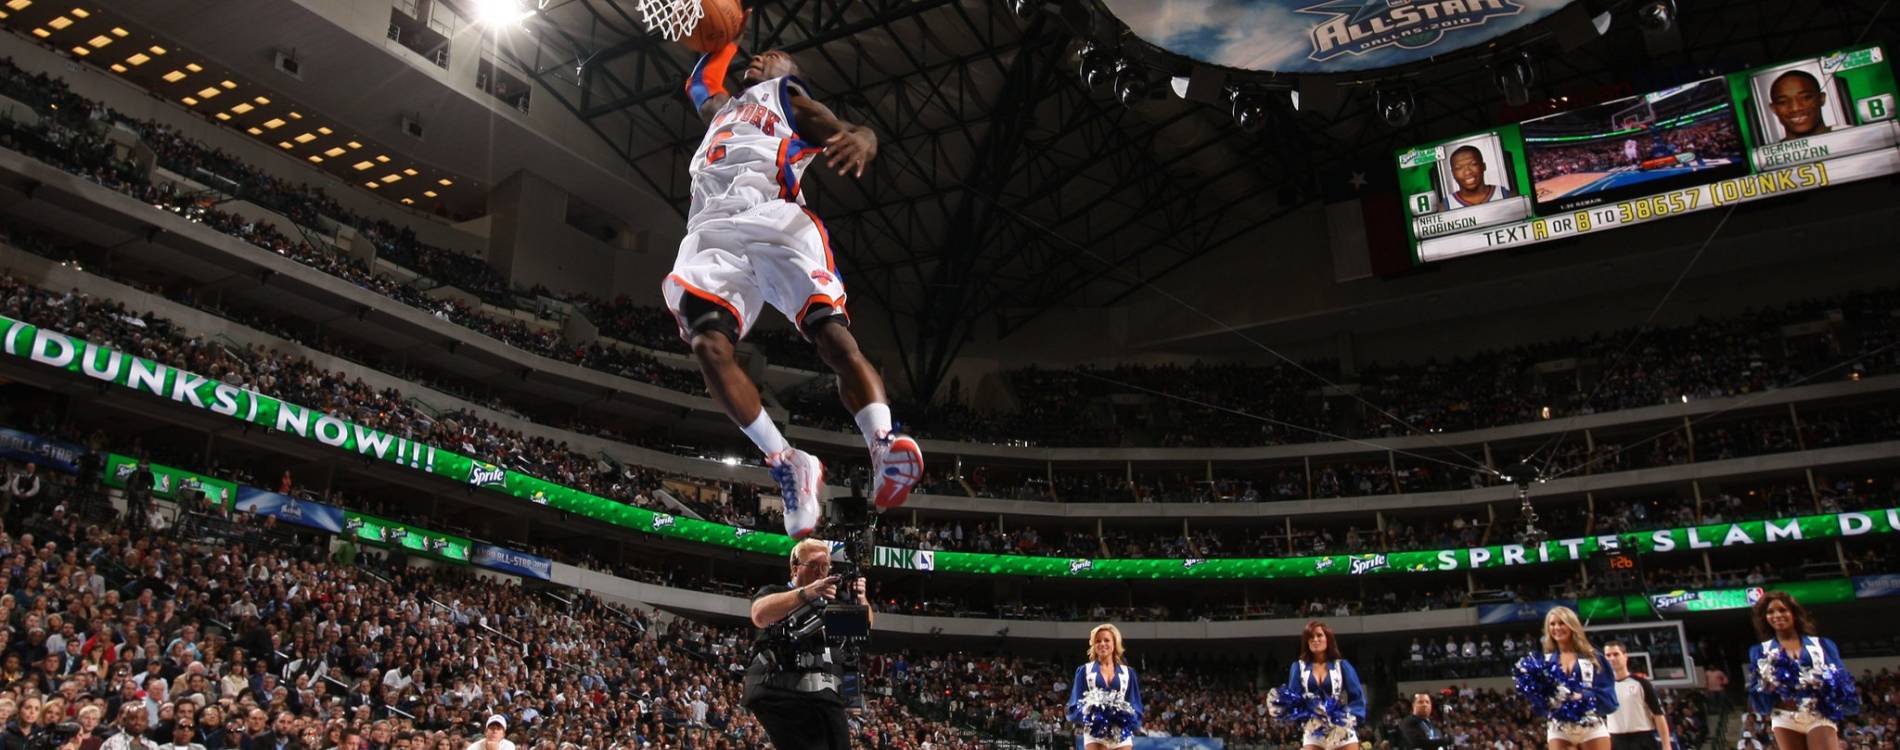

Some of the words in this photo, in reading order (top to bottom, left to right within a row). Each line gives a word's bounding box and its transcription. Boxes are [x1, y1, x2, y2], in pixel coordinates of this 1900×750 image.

[1868, 98, 1885, 118] B
[1764, 145, 1829, 167] DEROZAN
[1417, 195, 1430, 213] A
[1418, 215, 1443, 225] NATE
[1421, 216, 1477, 236] ROBINSON
[1484, 224, 1528, 246] TEXT
[1532, 219, 1549, 241] A
[1552, 218, 1572, 233] OR
[1574, 210, 1592, 232] B
[1594, 210, 1615, 225] TO
[1617, 188, 1701, 223] 38657
[5, 322, 258, 422] (DUNKS)
[276, 400, 435, 473] NOW!!!
[470, 465, 504, 486] Sprite
[1437, 534, 1618, 571] SPRITE
[1652, 518, 1803, 552] SLAM
[875, 546, 918, 570] UNK
[1352, 554, 1385, 575] Sprite
[1656, 591, 1696, 608] Sprite
